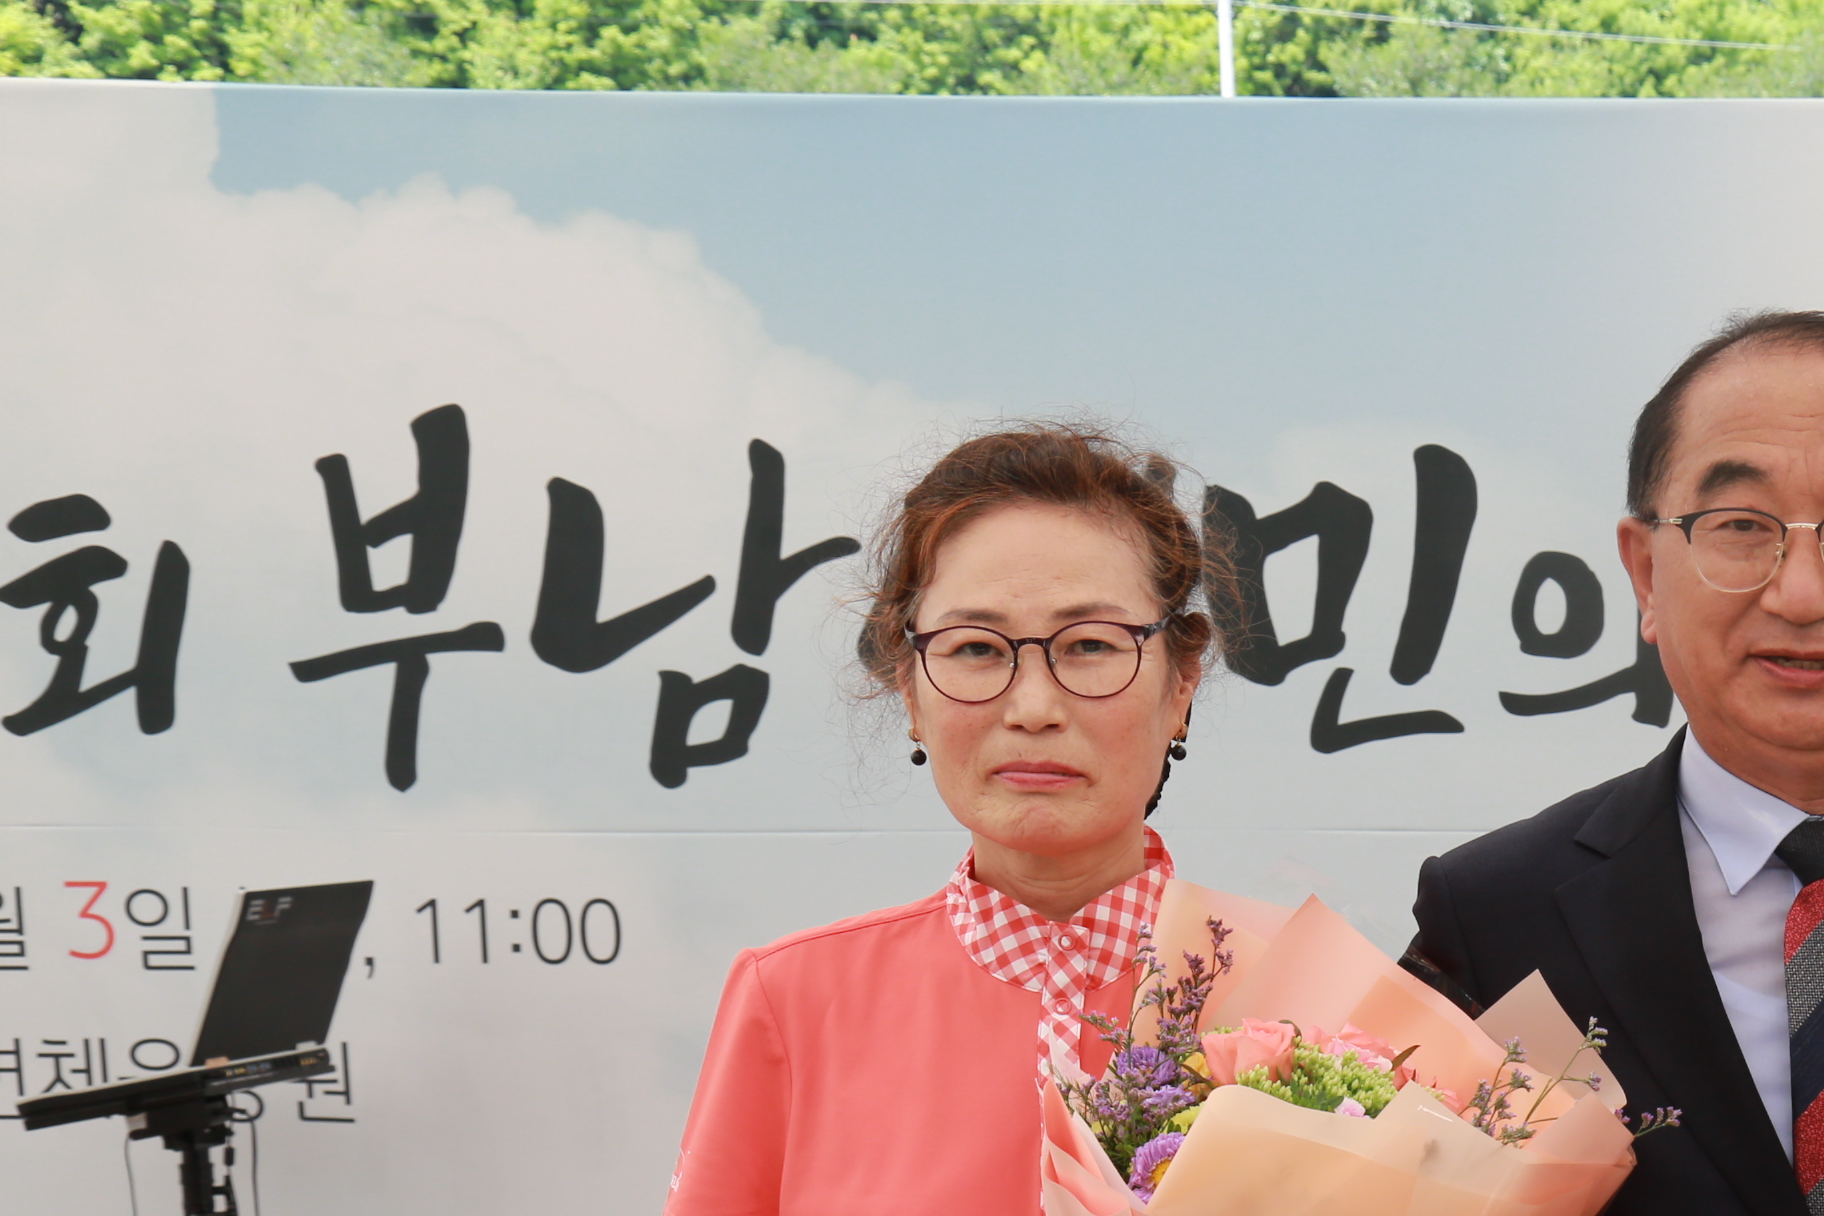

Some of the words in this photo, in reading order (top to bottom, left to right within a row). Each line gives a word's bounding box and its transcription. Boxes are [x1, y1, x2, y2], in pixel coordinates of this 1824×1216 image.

[0, 493, 191, 736] 회
[288, 403, 862, 793] 부남
[415, 897, 624, 967] 11:00
